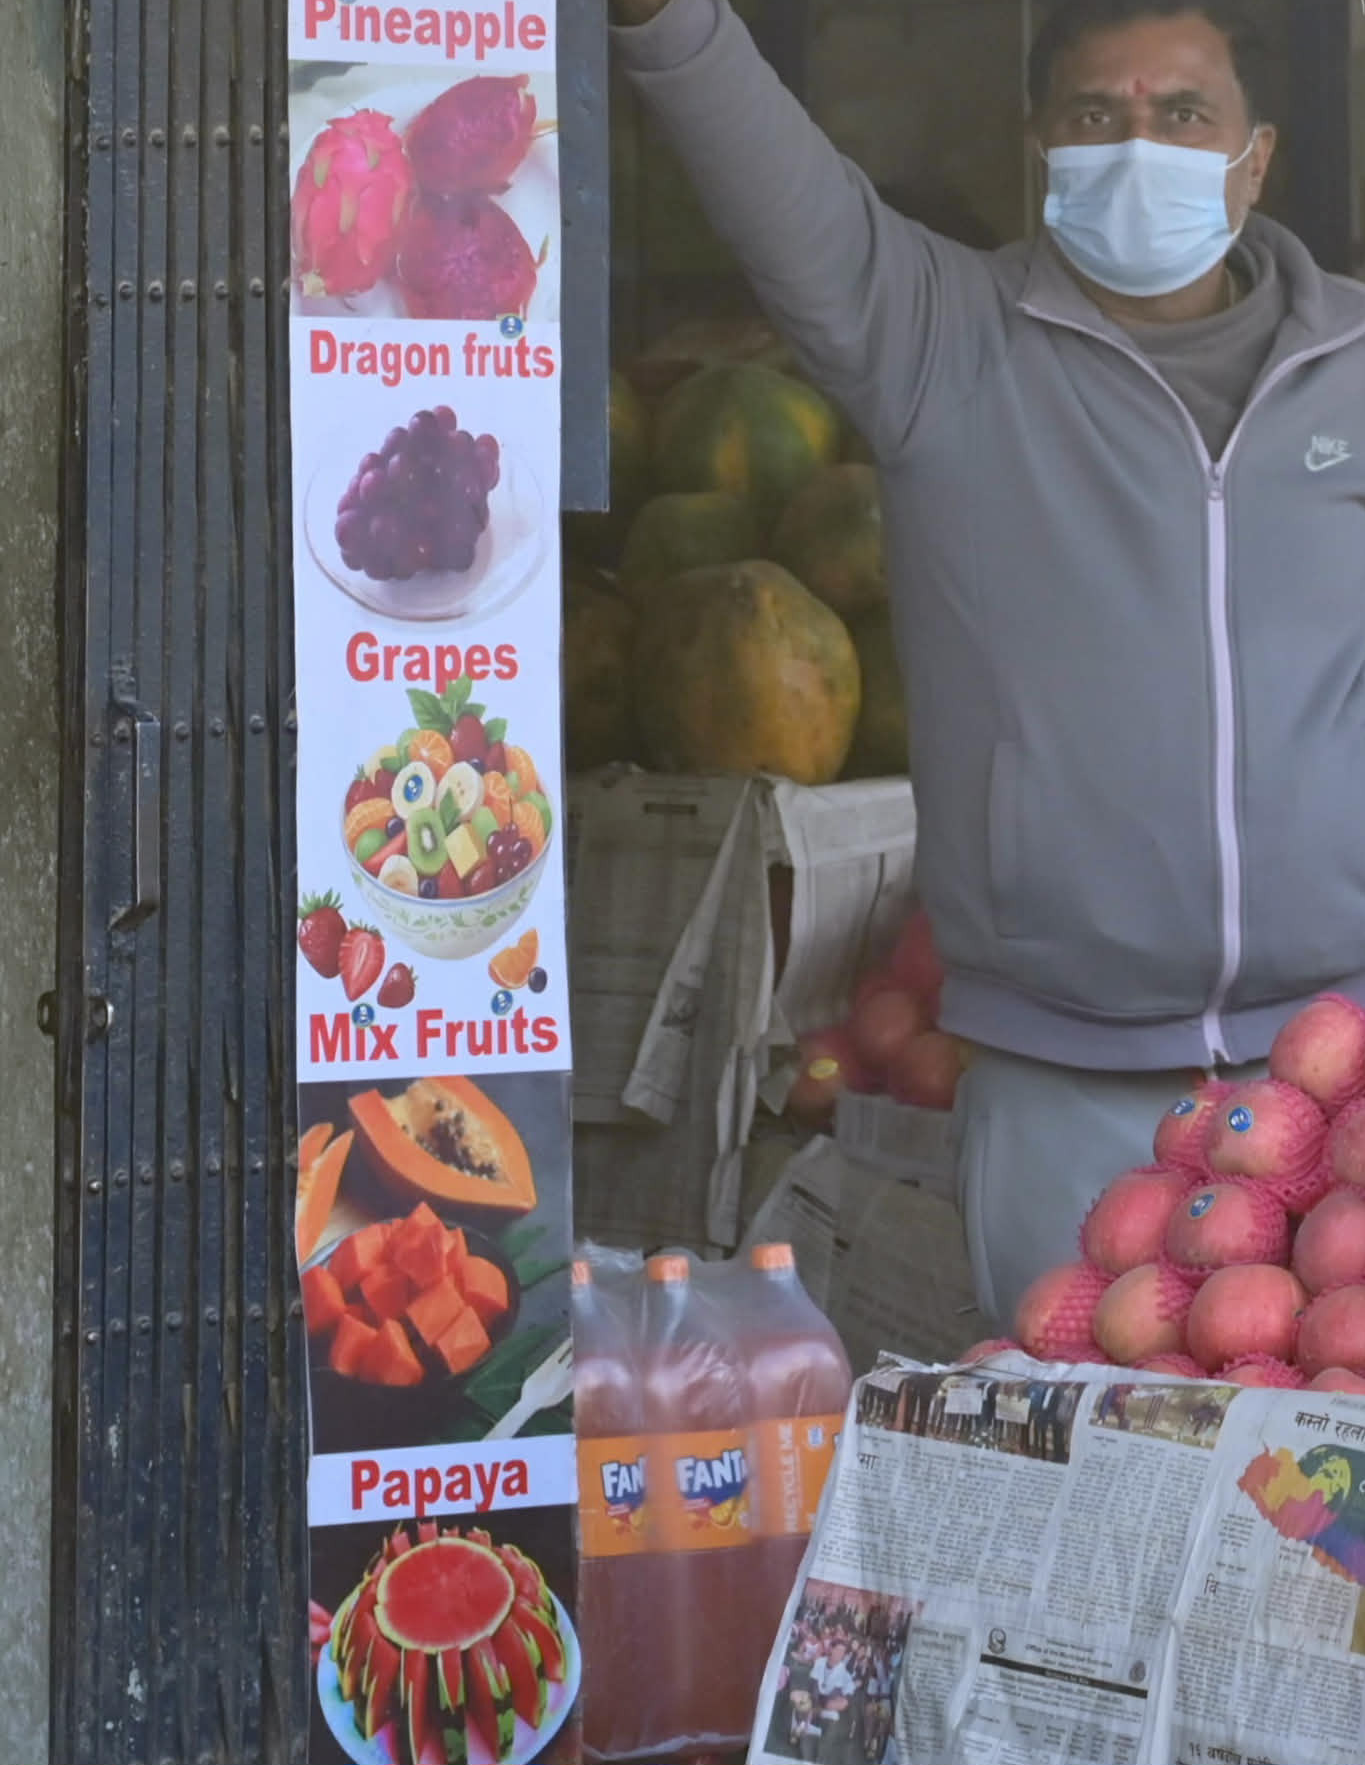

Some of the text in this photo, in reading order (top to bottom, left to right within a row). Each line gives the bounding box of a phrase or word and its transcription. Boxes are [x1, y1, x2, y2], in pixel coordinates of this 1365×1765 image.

[309, 329, 452, 387] Dragon
[345, 631, 520, 694] Grapes
[309, 1006, 559, 1063] Mix Fruits
[351, 1459, 529, 1518] Papaya
